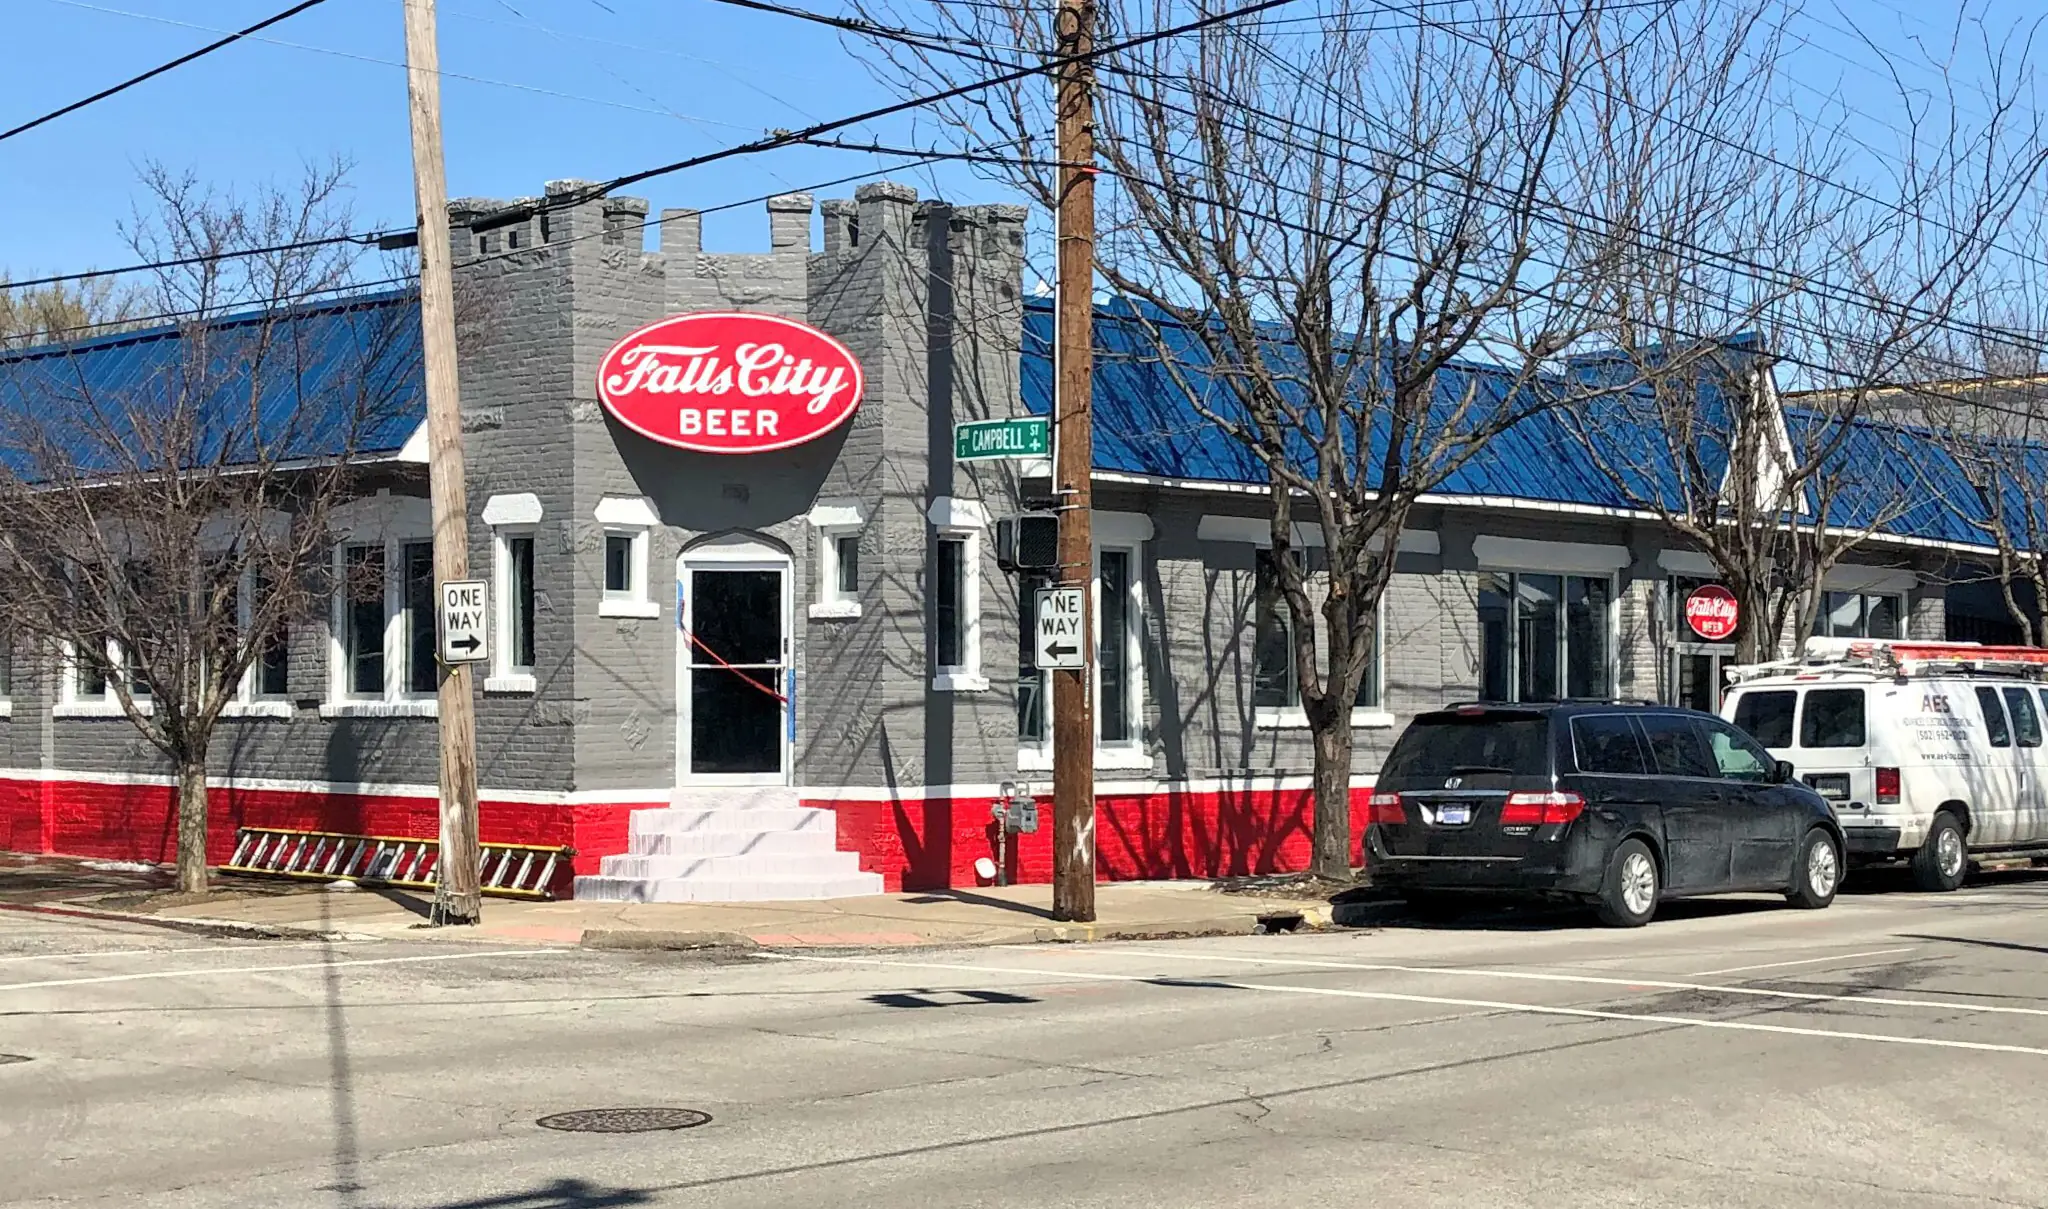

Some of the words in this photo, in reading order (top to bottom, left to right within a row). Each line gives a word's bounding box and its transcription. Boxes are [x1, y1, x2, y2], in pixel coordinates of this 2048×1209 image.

[606, 343, 734, 397] Falls
[735, 343, 849, 415] City
[679, 409, 779, 436] BEER
[961, 444, 966, 456] S
[972, 427, 1026, 452] CAMPBELL
[1029, 424, 1040, 436] ST
[448, 589, 481, 607] ONE
[447, 611, 482, 630] WAY
[1042, 617, 1080, 637] WAY
[1702, 621, 1724, 634] BEER
[1921, 695, 1950, 713] AES
